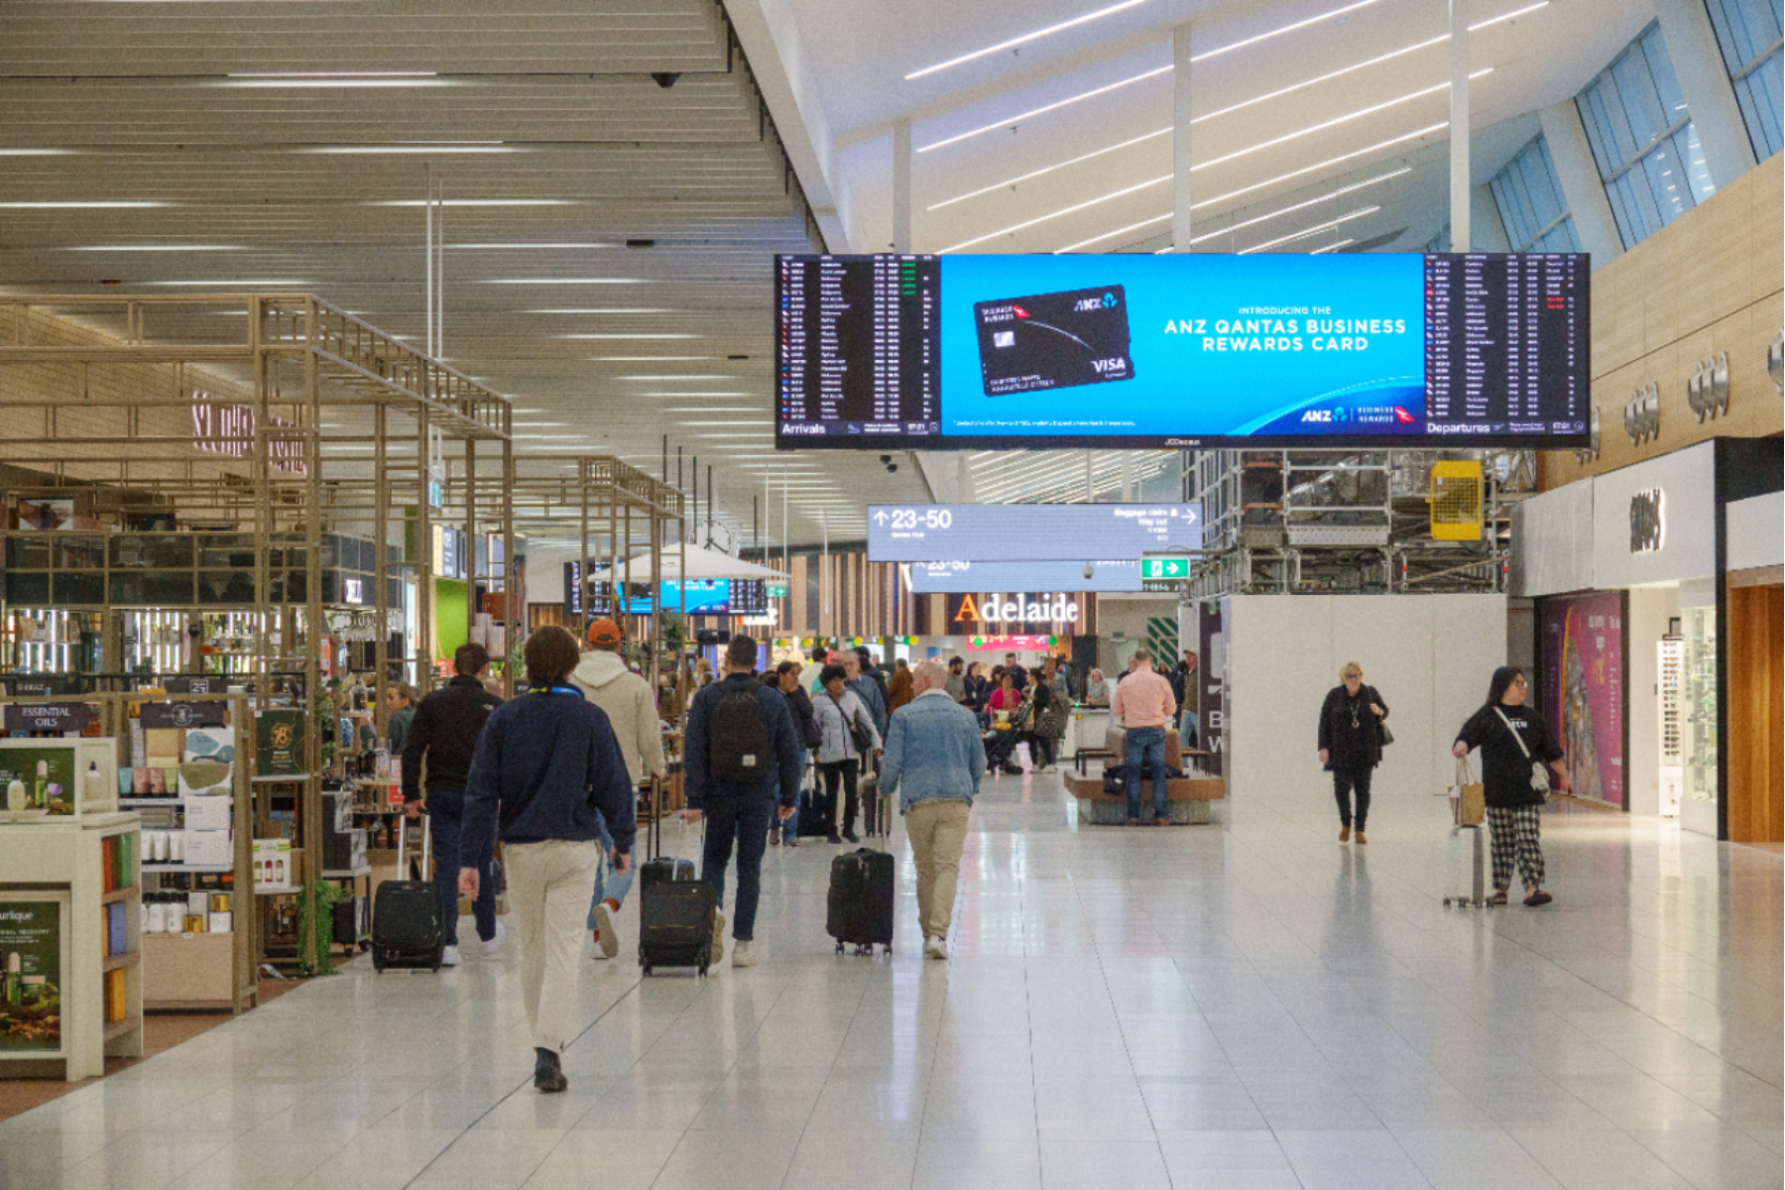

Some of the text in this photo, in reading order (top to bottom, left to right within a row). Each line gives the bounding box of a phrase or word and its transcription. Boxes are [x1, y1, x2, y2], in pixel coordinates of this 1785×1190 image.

[1073, 298, 1102, 312] ANZ
[1239, 307, 1331, 315] INTRODUCING THE
[1164, 319, 1407, 334] ANZ QANTAS BUSINESS
[1203, 337, 1369, 351] REWARDS CARD
[1091, 357, 1126, 373] VISA
[1301, 410, 1332, 422] ANZ
[782, 423, 826, 434] Arrivals
[1427, 422, 1490, 435] Departures
[891, 509, 952, 529] 23-50
[955, 593, 1079, 622] Adelaide
[22, 707, 71, 717] ESSENTIAL
[35, 718, 58, 727] OILS
